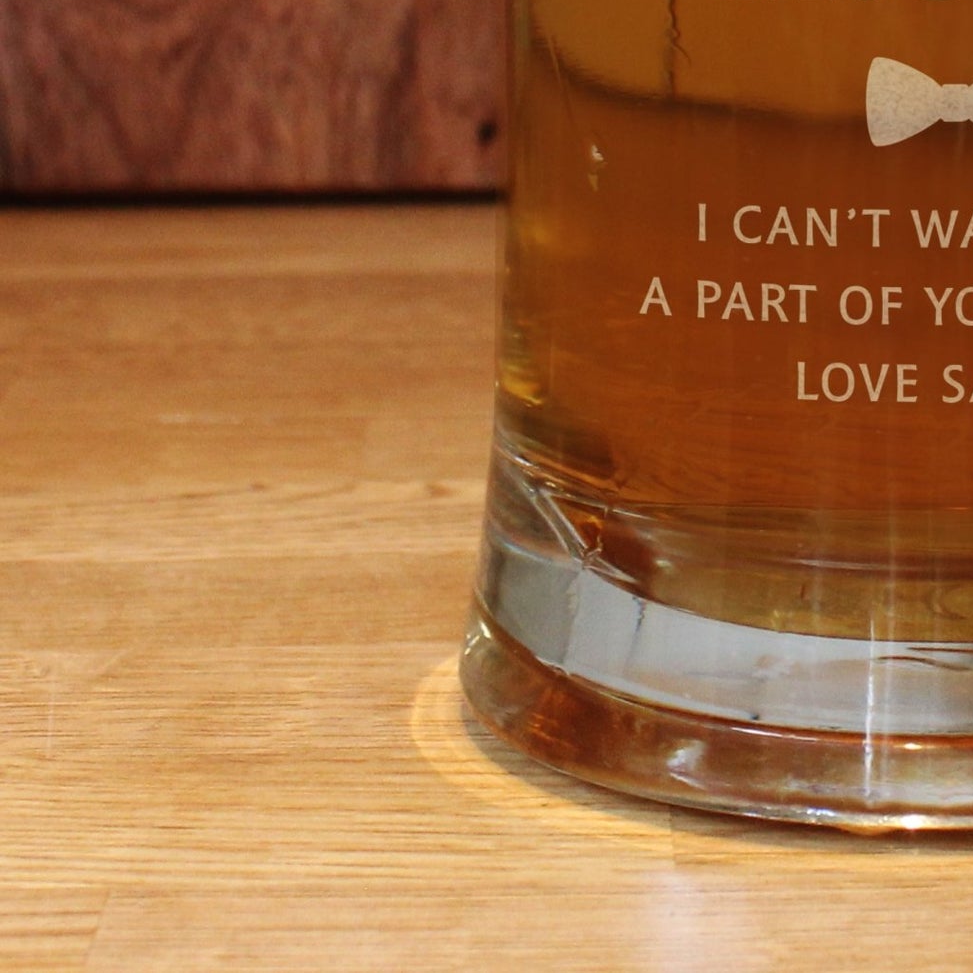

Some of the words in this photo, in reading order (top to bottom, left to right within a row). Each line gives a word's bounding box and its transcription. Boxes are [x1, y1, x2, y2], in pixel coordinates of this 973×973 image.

[697, 203, 708, 243] I
[733, 205, 891, 248] CAN’T
[639, 276, 672, 316] A
[697, 279, 817, 323] PART
[839, 285, 903, 326] OF
[797, 361, 918, 403] LOVE
